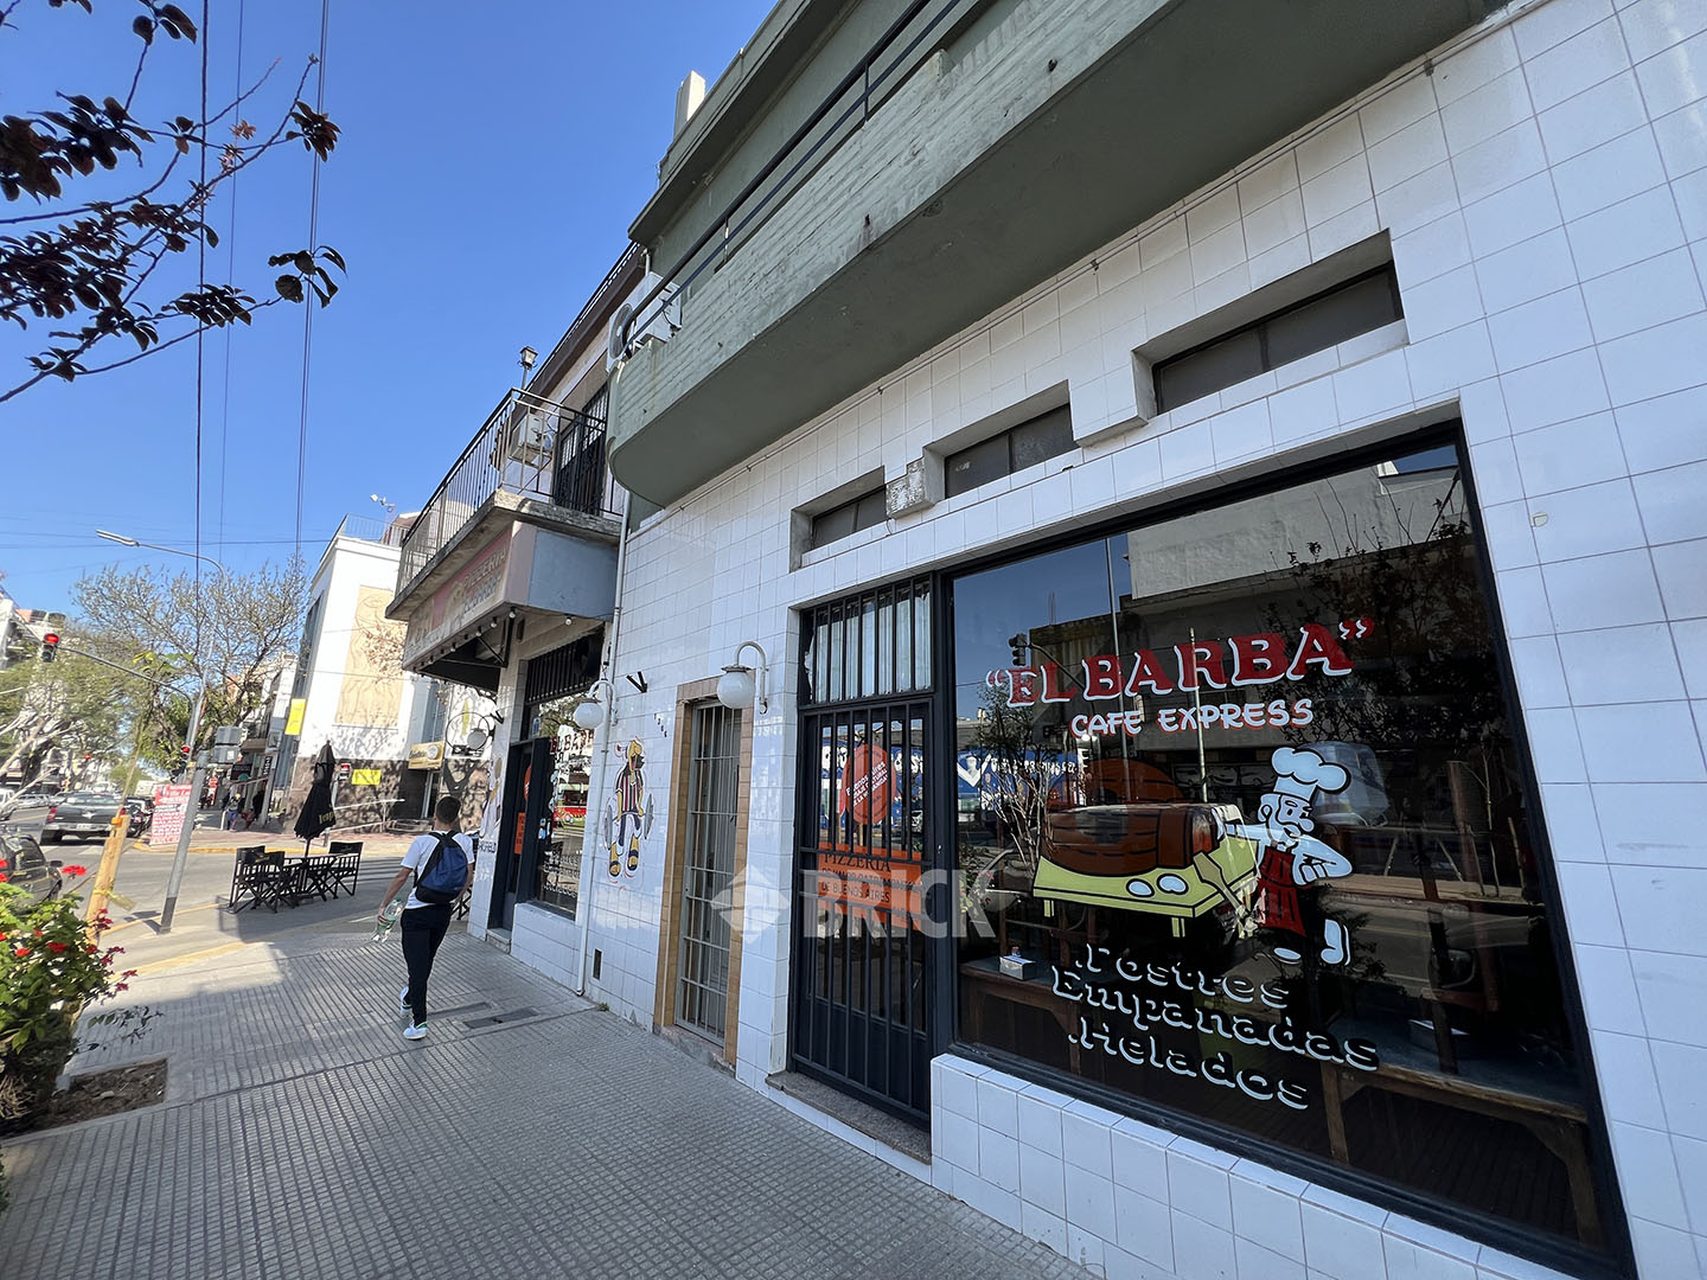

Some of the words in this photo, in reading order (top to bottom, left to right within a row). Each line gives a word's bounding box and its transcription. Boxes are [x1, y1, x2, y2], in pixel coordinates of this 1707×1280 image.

[1070, 709, 1143, 739] CAFE
[1158, 698, 1315, 736] EXPRESS
[824, 854, 892, 872] PIZZERIA
[1075, 943, 1290, 1009] Postres
[1052, 965, 1379, 1072] Empanadas
[1068, 1016, 1309, 1110] Helados
